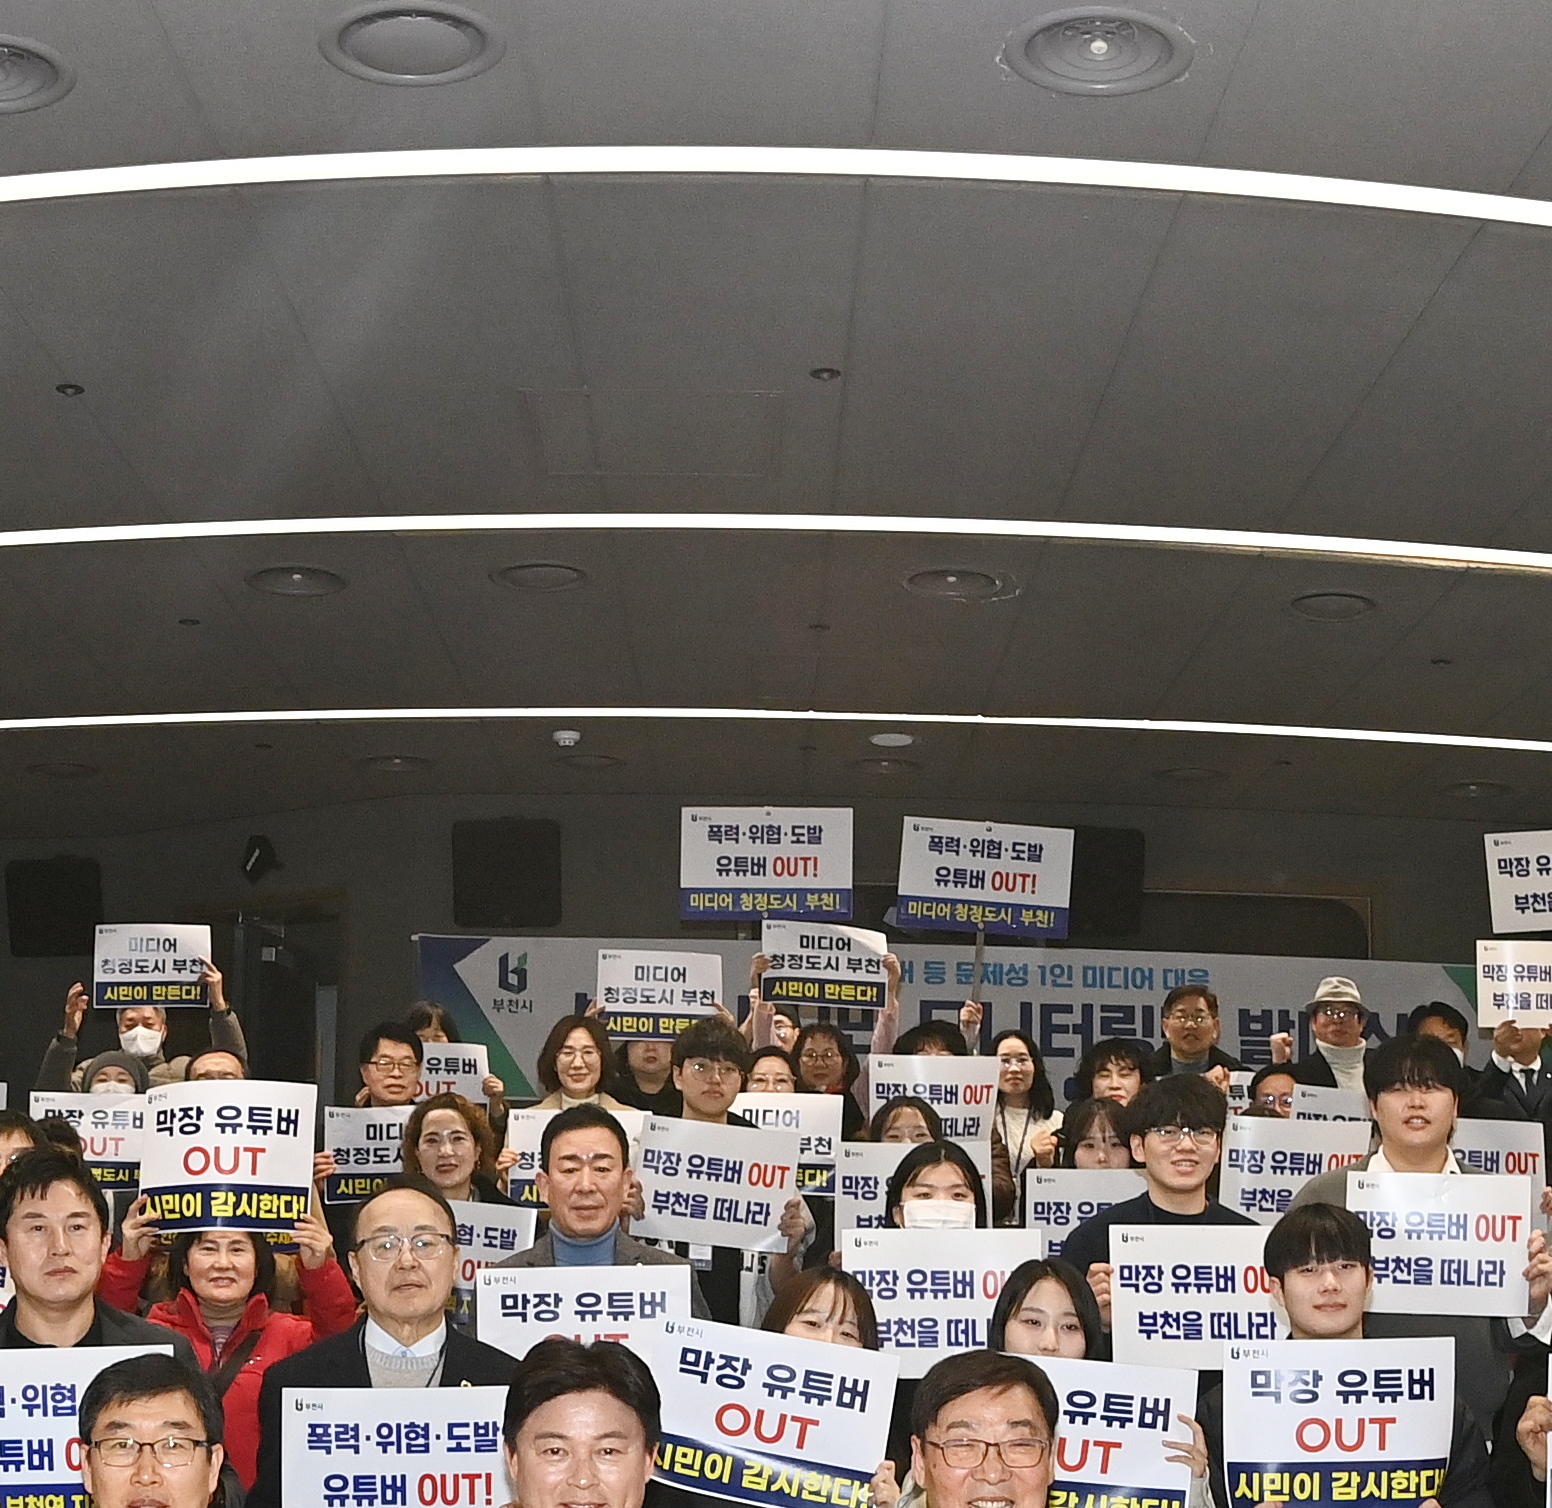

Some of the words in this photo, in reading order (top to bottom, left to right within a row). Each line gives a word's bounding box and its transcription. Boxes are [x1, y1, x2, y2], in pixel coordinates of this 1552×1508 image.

[708, 824, 823, 845] 폭력·위협·도발
[929, 835, 1043, 863] 폭력·위협·도발
[716, 856, 766, 877] 유튜버
[773, 857, 818, 877] OUT!
[935, 866, 985, 890] 유튜버
[992, 871, 1036, 894] OUT!
[1498, 857, 1530, 878] 막장
[909, 902, 951, 920] 미디어
[955, 904, 1011, 923] 청정도시
[1021, 910, 1054, 927] 부천!
[800, 935, 851, 952] 미디어
[635, 965, 686, 983] 미디어
[769, 954, 839, 972] 청정도시
[846, 957, 880, 974] 부천
[923, 962, 946, 984] 등
[1082, 966, 1154, 990] 미디어
[105, 986, 147, 1000] 시민이
[492, 998, 532, 1013] 부천시
[772, 982, 819, 997] 시민이
[825, 984, 877, 1001] 만든다!
[606, 1017, 653, 1032] 시민이
[156, 1106, 204, 1137] 막장
[215, 1106, 299, 1137] 유튜버
[183, 1146, 266, 1176] OUT
[643, 1149, 682, 1176] 막장
[686, 1155, 743, 1184] 유튜버
[748, 1163, 790, 1189] OUT
[211, 1192, 305, 1220] 감시한다!
[652, 1190, 708, 1219] 부천을
[713, 1198, 770, 1226] 떠나라
[677, 1325, 703, 1338] 부천시
[1243, 1349, 1268, 1359] 부천시
[679, 1347, 752, 1389] 막장
[762, 1364, 870, 1413] 유튜버
[1251, 1370, 1323, 1404] 막장
[1336, 1368, 1434, 1404] 유튜버
[307, 1421, 499, 1455] 폭력·위협·도발
[713, 1403, 819, 1451] OUT
[1296, 1417, 1396, 1452] OUT
[324, 1474, 406, 1507] 유튜버
[418, 1473, 492, 1506] OUT!
[1235, 1472, 1320, 1503] 시민이
